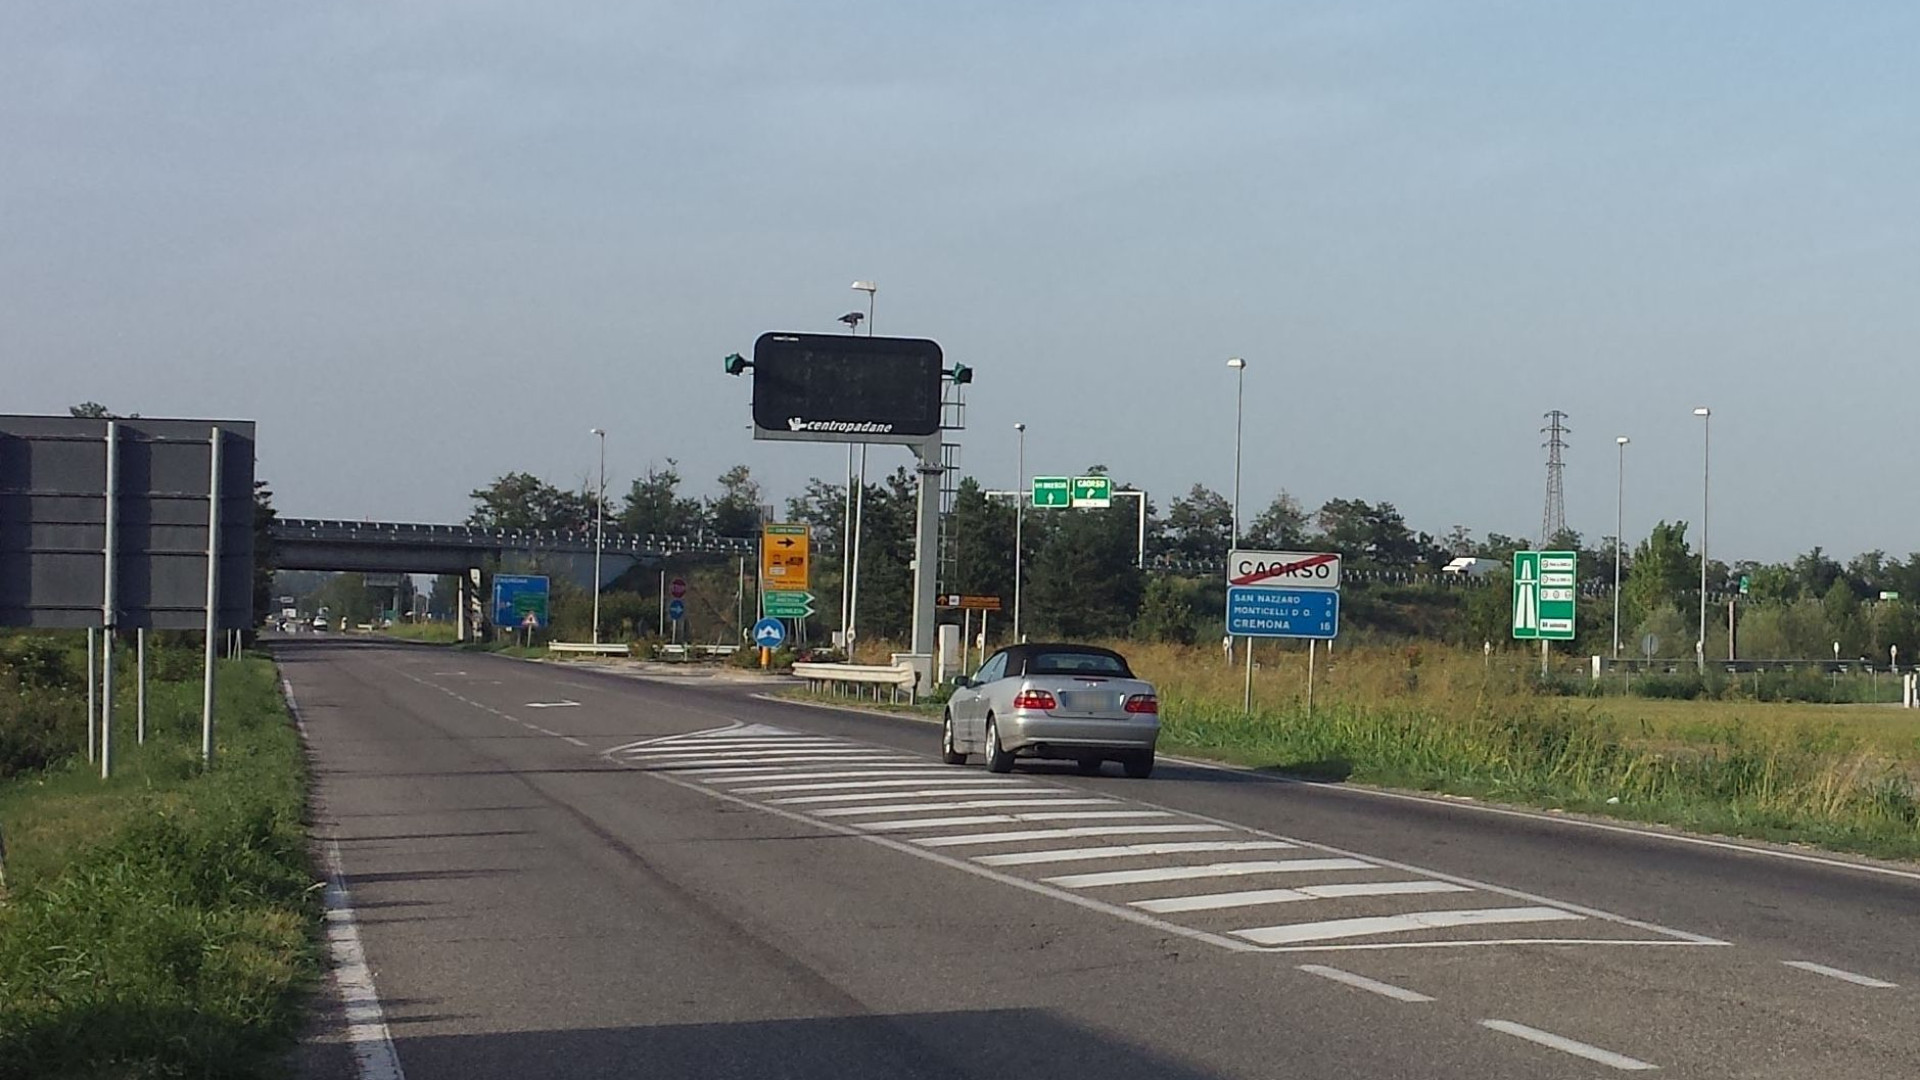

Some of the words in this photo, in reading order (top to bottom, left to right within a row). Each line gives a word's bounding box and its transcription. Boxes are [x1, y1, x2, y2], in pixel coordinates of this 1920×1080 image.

[807, 420, 893, 433] centropadane
[1239, 560, 1330, 579] CAORSO
[1234, 594, 1254, 603] SAN
[1258, 595, 1301, 604] NAZZARO
[1326, 597, 1333, 605] 3
[1234, 606, 1288, 617] MONTICELLI
[1325, 610, 1332, 618] 6
[1233, 619, 1290, 630] CREMONA
